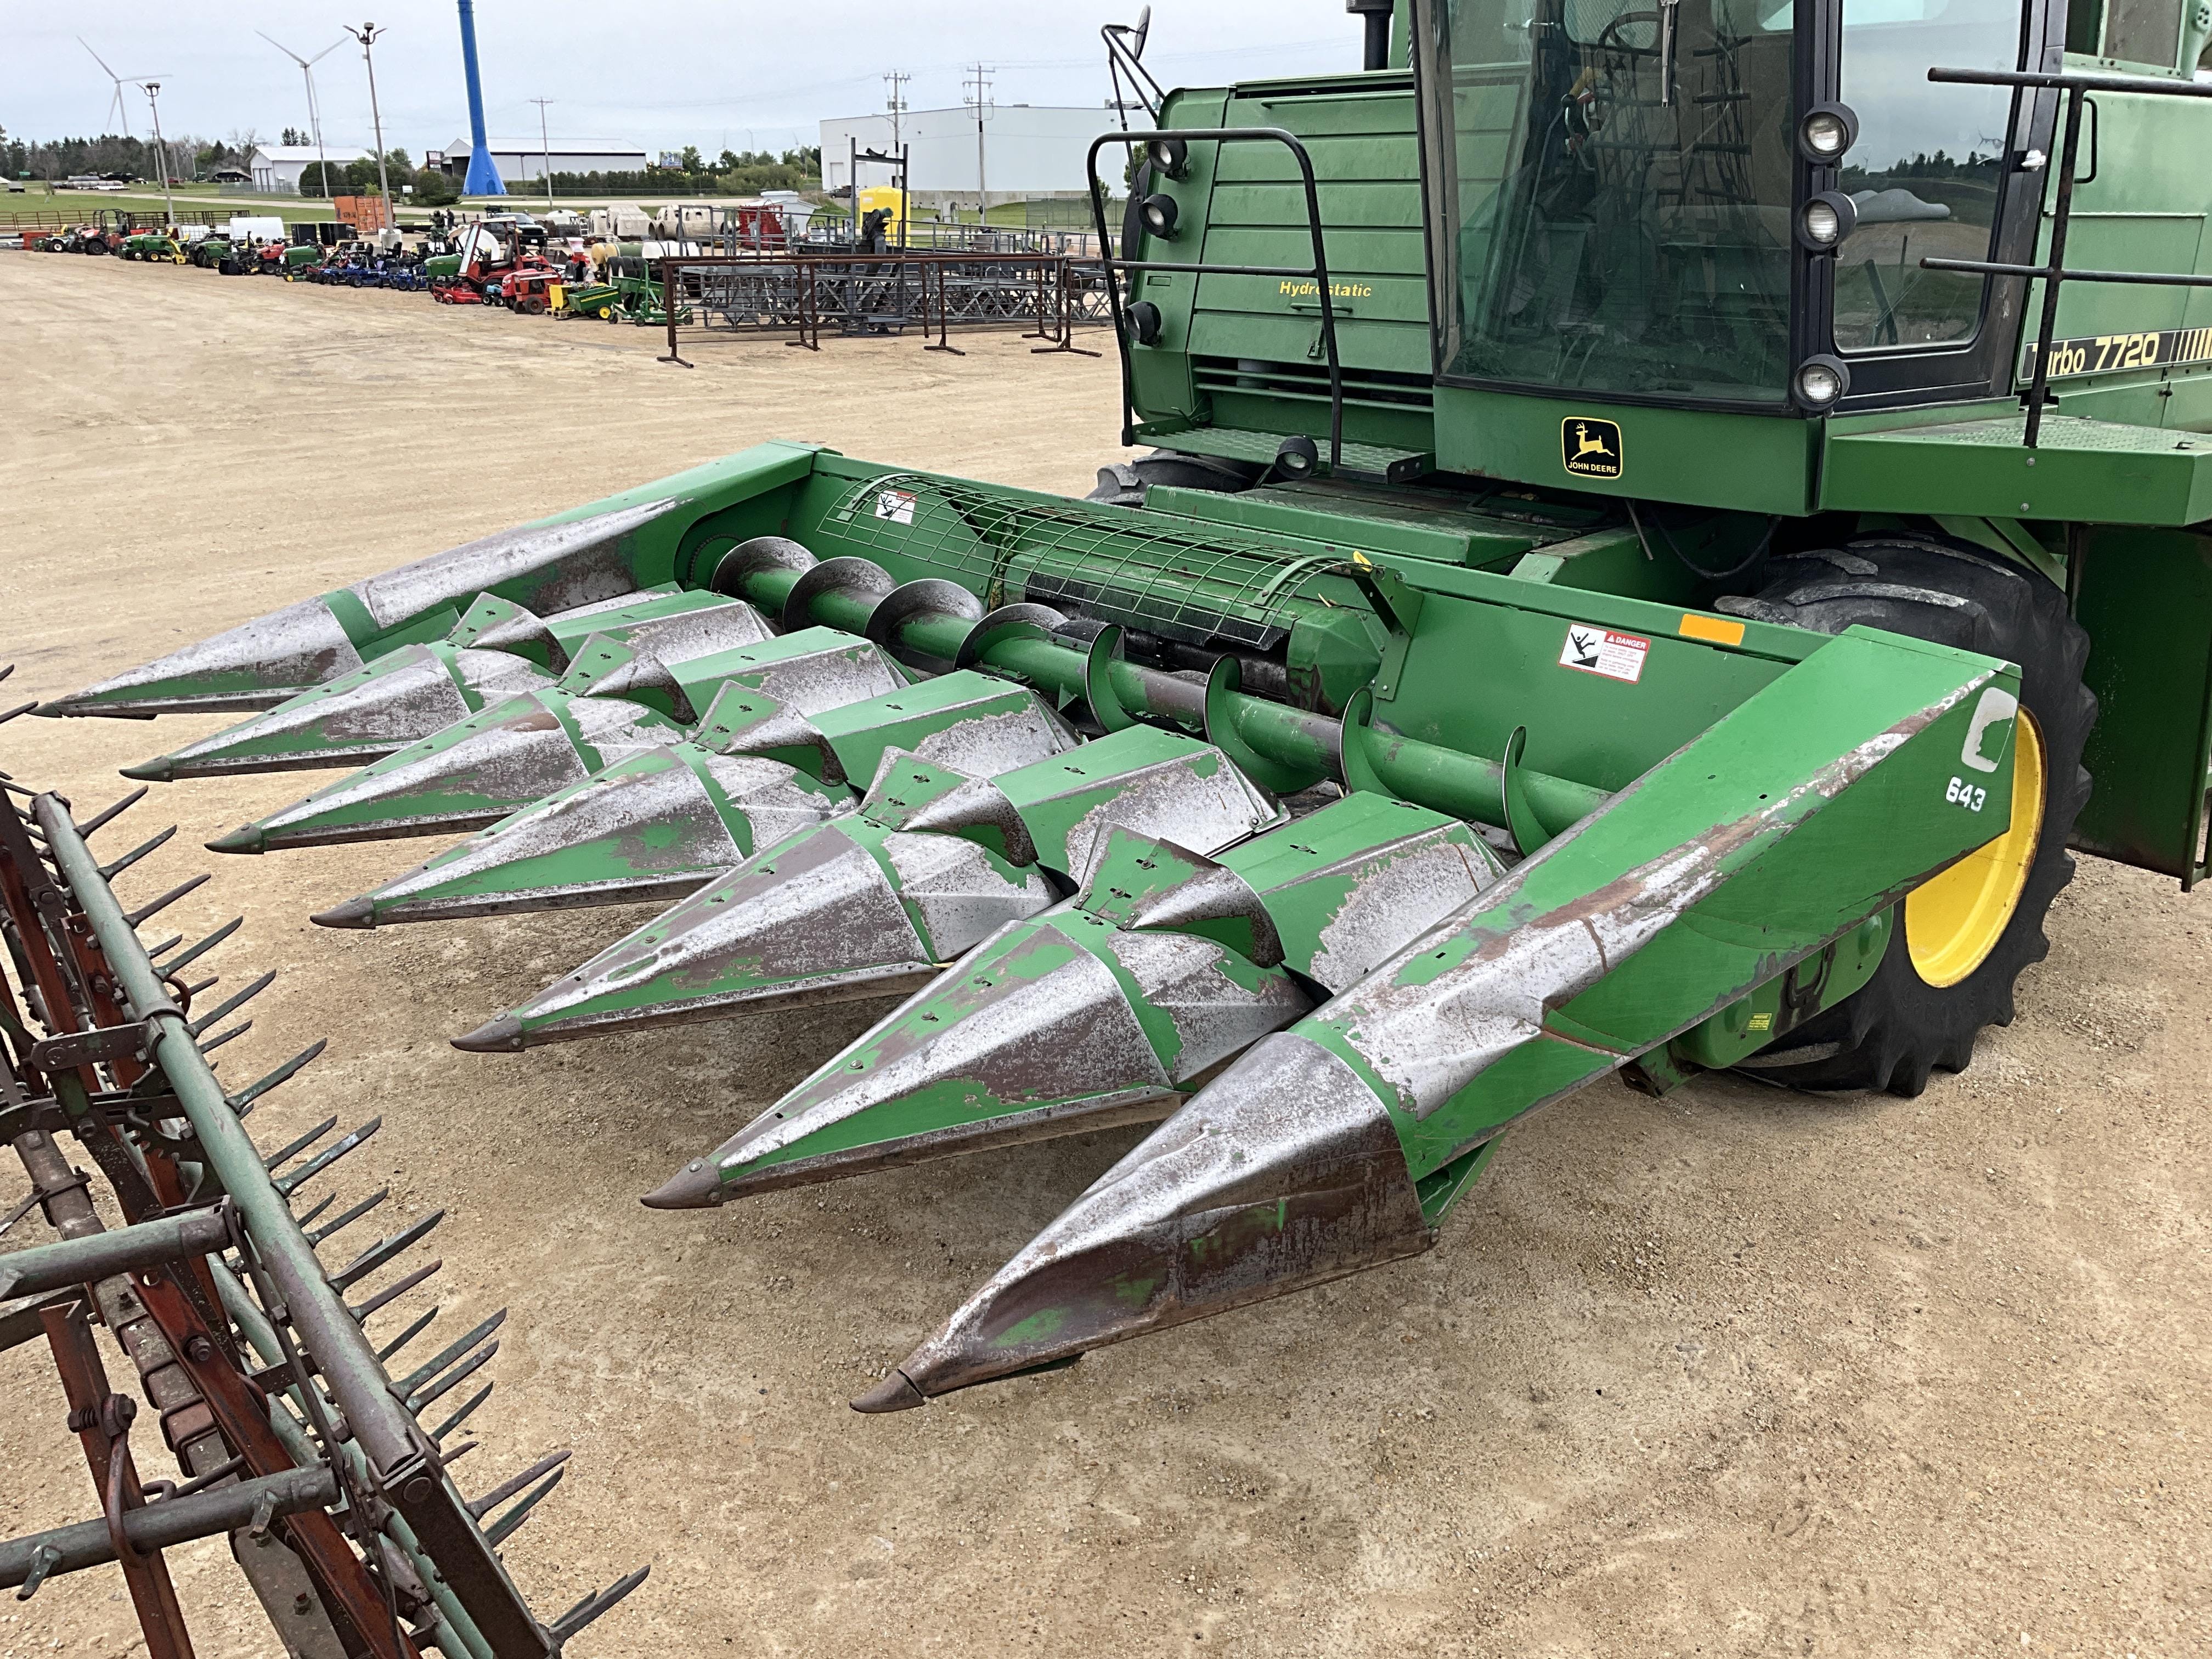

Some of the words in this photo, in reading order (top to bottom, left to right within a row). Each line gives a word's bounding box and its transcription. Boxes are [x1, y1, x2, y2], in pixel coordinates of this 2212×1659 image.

[2032, 340, 2085, 377] rbo
[2094, 332, 2160, 371] 7720
[1568, 461, 1589, 471] JOHN
[1590, 464, 1617, 473] DEERE
[1615, 636, 1646, 649] DANGER
[1946, 776, 1986, 812] 643
